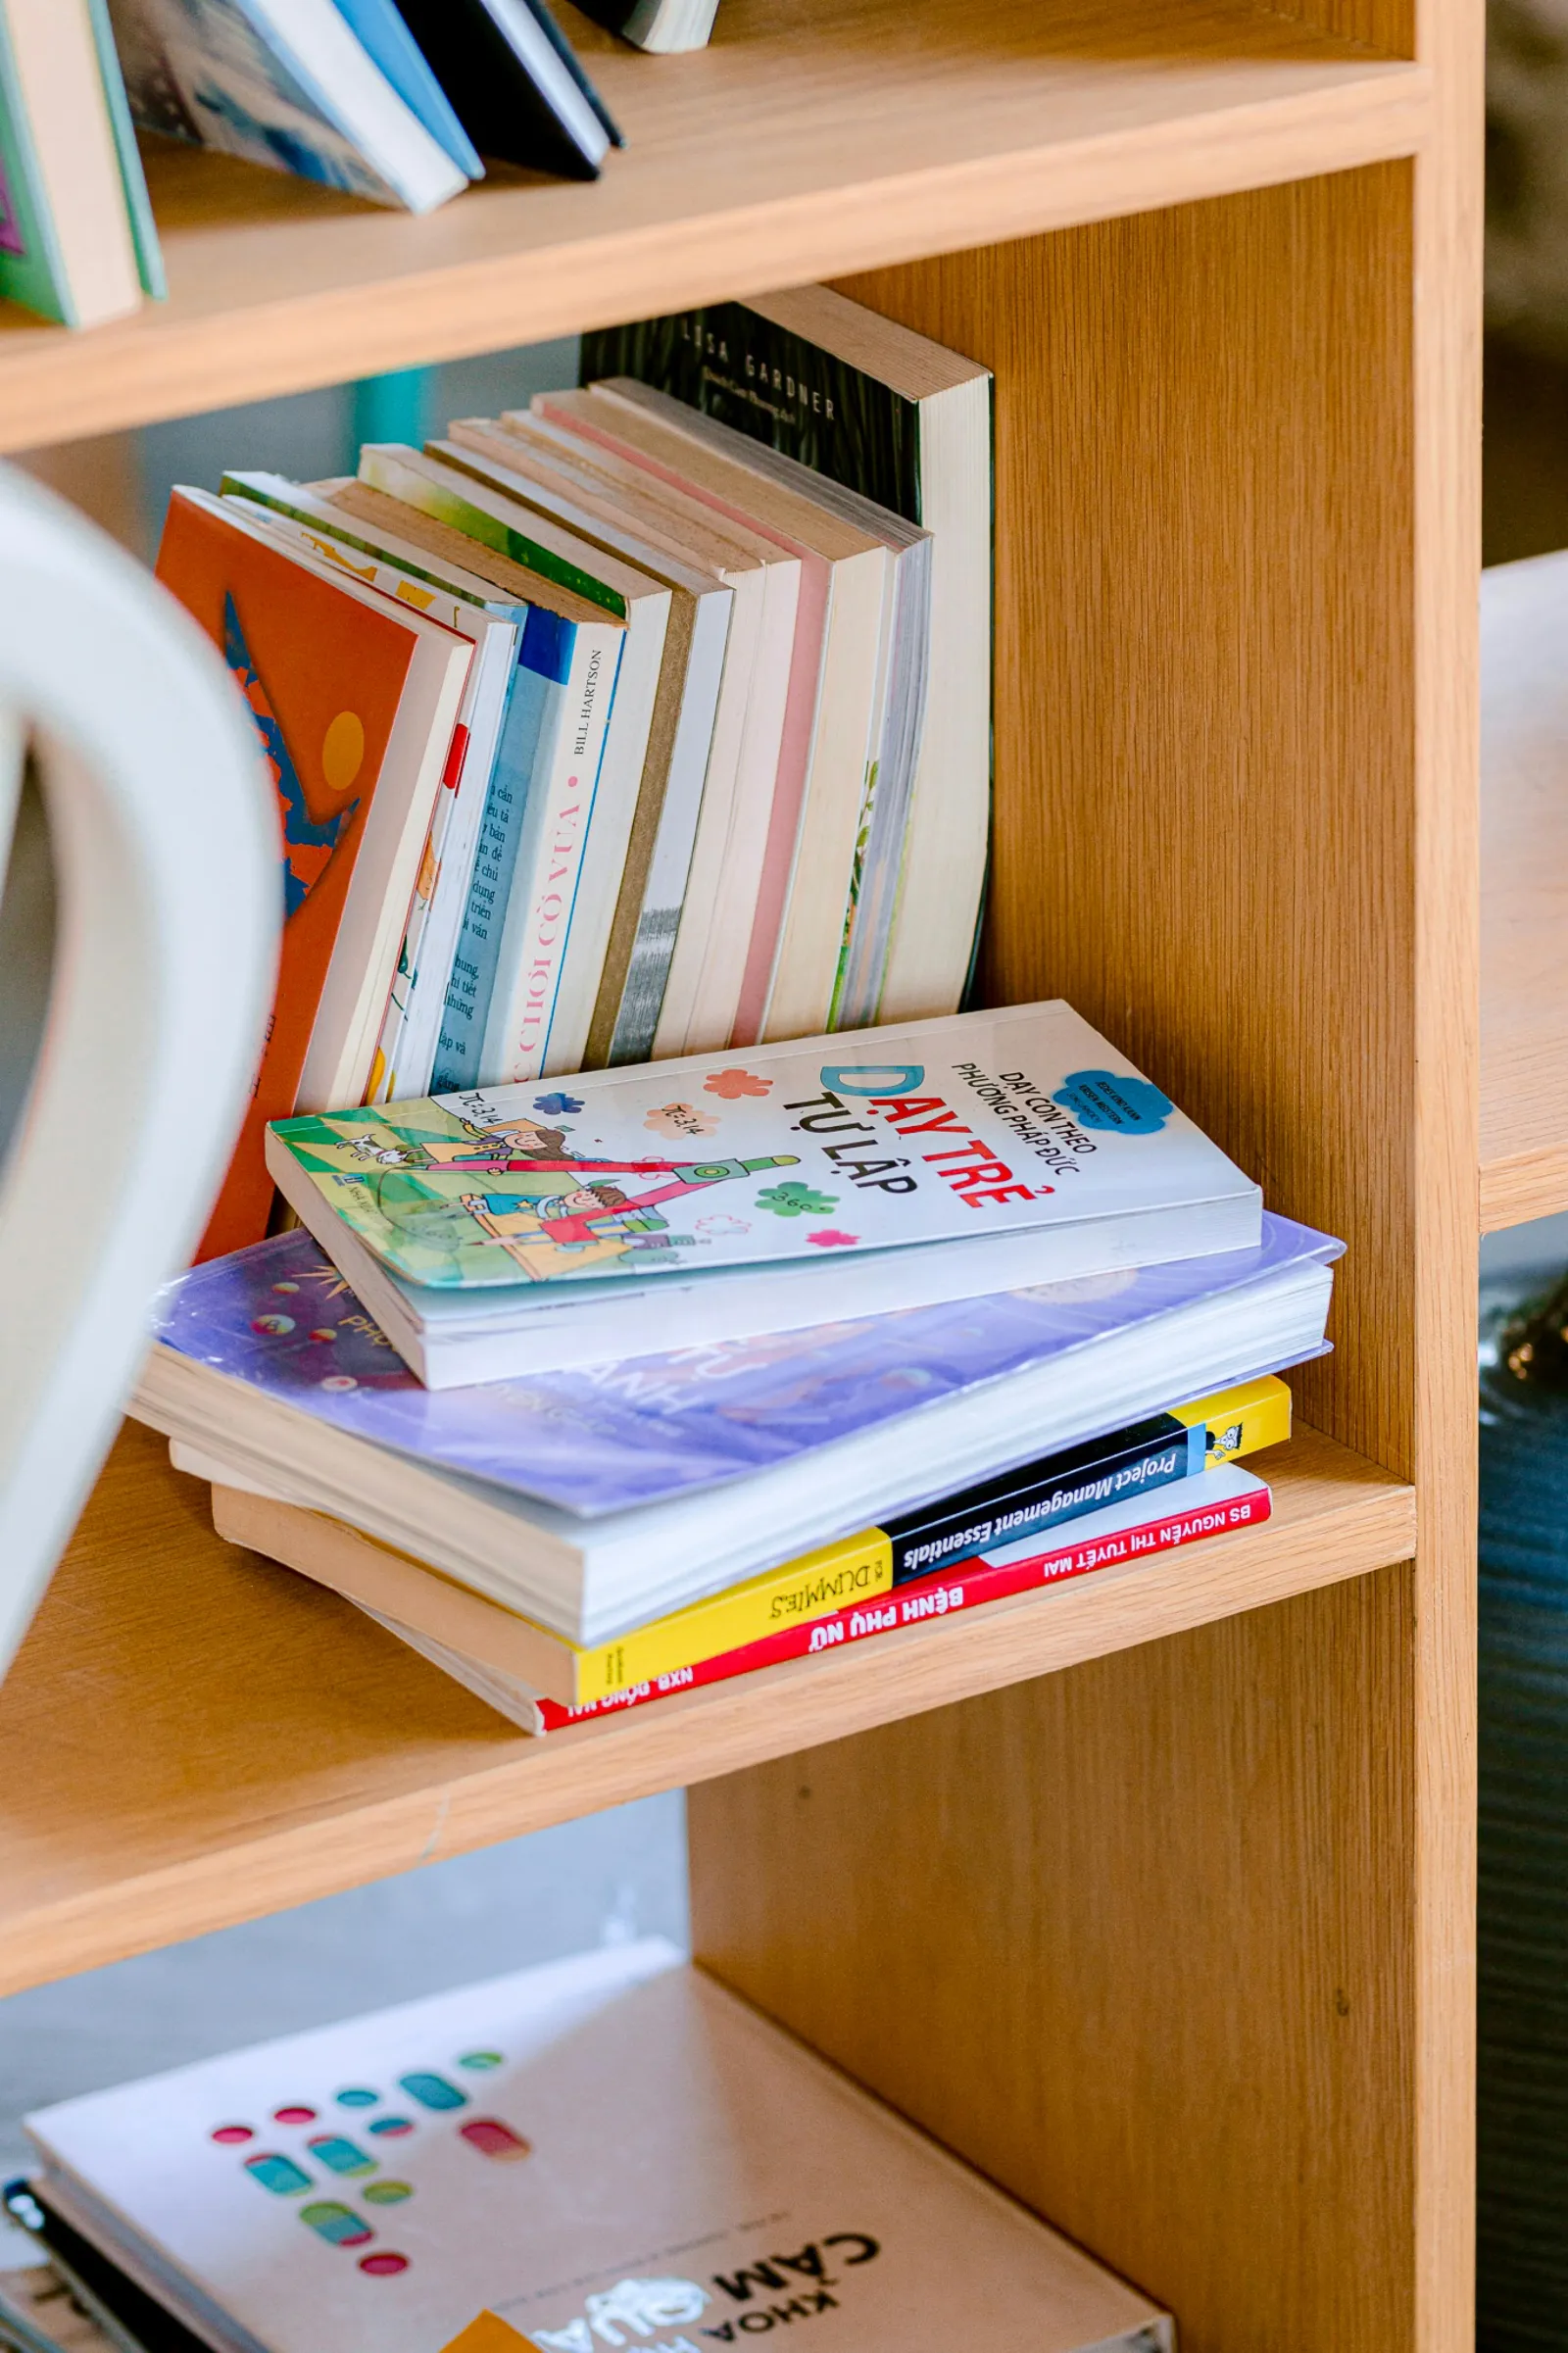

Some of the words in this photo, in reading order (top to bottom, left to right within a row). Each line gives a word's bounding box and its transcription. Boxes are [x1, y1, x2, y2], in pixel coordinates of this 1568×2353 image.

[745, 355, 836, 420] GARDNER
[581, 650, 603, 718] HARTSON
[574, 723, 589, 755] BILL
[455, 955, 479, 980] hung,
[782, 1091, 876, 1133] TỰ
[952, 1062, 1019, 1115] PHƯƠNG
[1002, 1114, 1051, 1148] PHÁP
[1035, 1148, 1080, 1175] ĐỨC
[999, 1071, 1041, 1096] DẠY
[1025, 1098, 1066, 1123] CON
[1051, 1121, 1098, 1153] THEO
[820, 1065, 973, 1135] DẠY
[921, 1139, 1055, 1208] TRẺ
[820, 1139, 918, 1194] LẬP
[1115, 1453, 1177, 1491] Project
[995, 1477, 1113, 1537] Management
[1159, 1511, 1226, 1545] NGUYỄN
[1229, 1504, 1251, 1522] BS
[904, 1521, 993, 1570] Essentials
[1075, 1543, 1128, 1571] TUYẾT
[1130, 1533, 1156, 1551] THỊ
[1044, 1558, 1073, 1578] MAI
[769, 1565, 871, 1619] DUMMIES
[902, 1586, 964, 1616] BỆNH
[850, 1605, 897, 1638] PHỤ
[699, 2289, 841, 2343] KHOA
